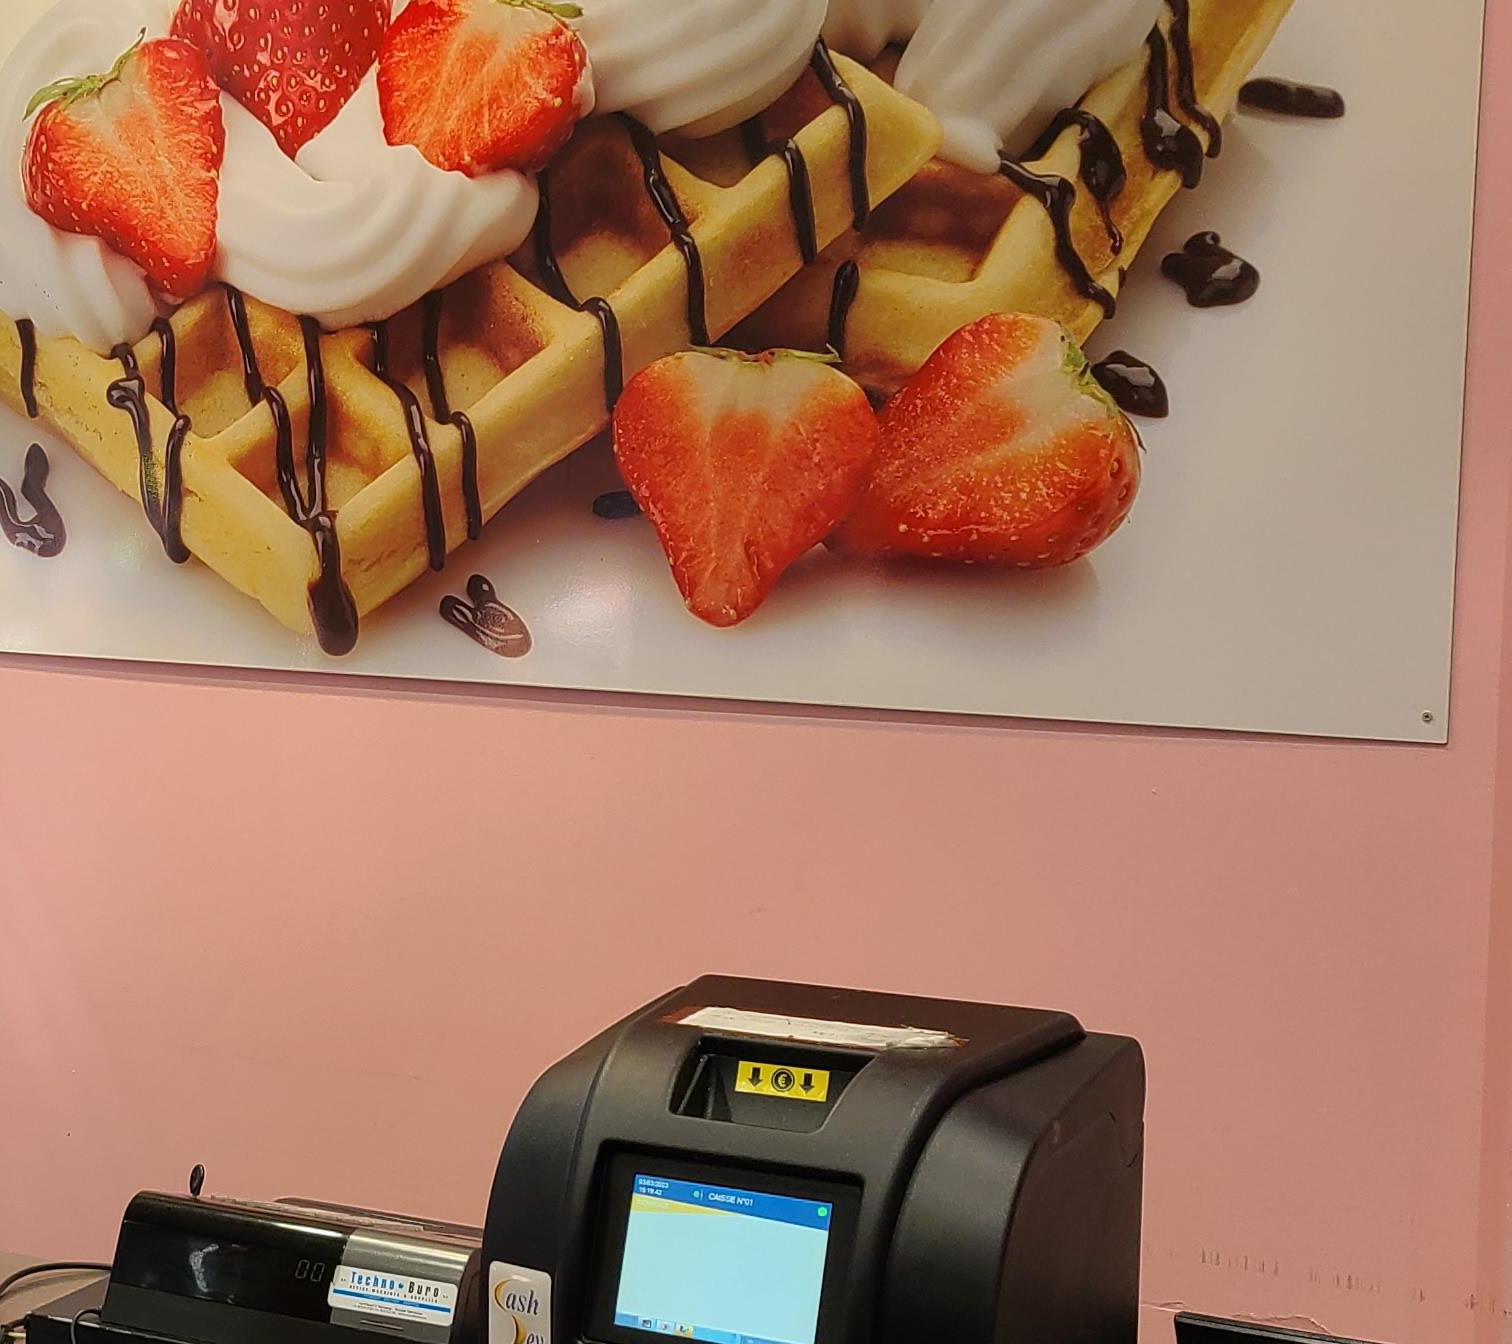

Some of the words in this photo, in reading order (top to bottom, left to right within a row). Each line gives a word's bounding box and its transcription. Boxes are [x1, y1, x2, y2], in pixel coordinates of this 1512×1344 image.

[708, 1192, 736, 1205] CAISSE
[350, 1271, 395, 1290] Techno
[408, 1280, 440, 1298] Buro
[493, 1279, 539, 1316] Cash
